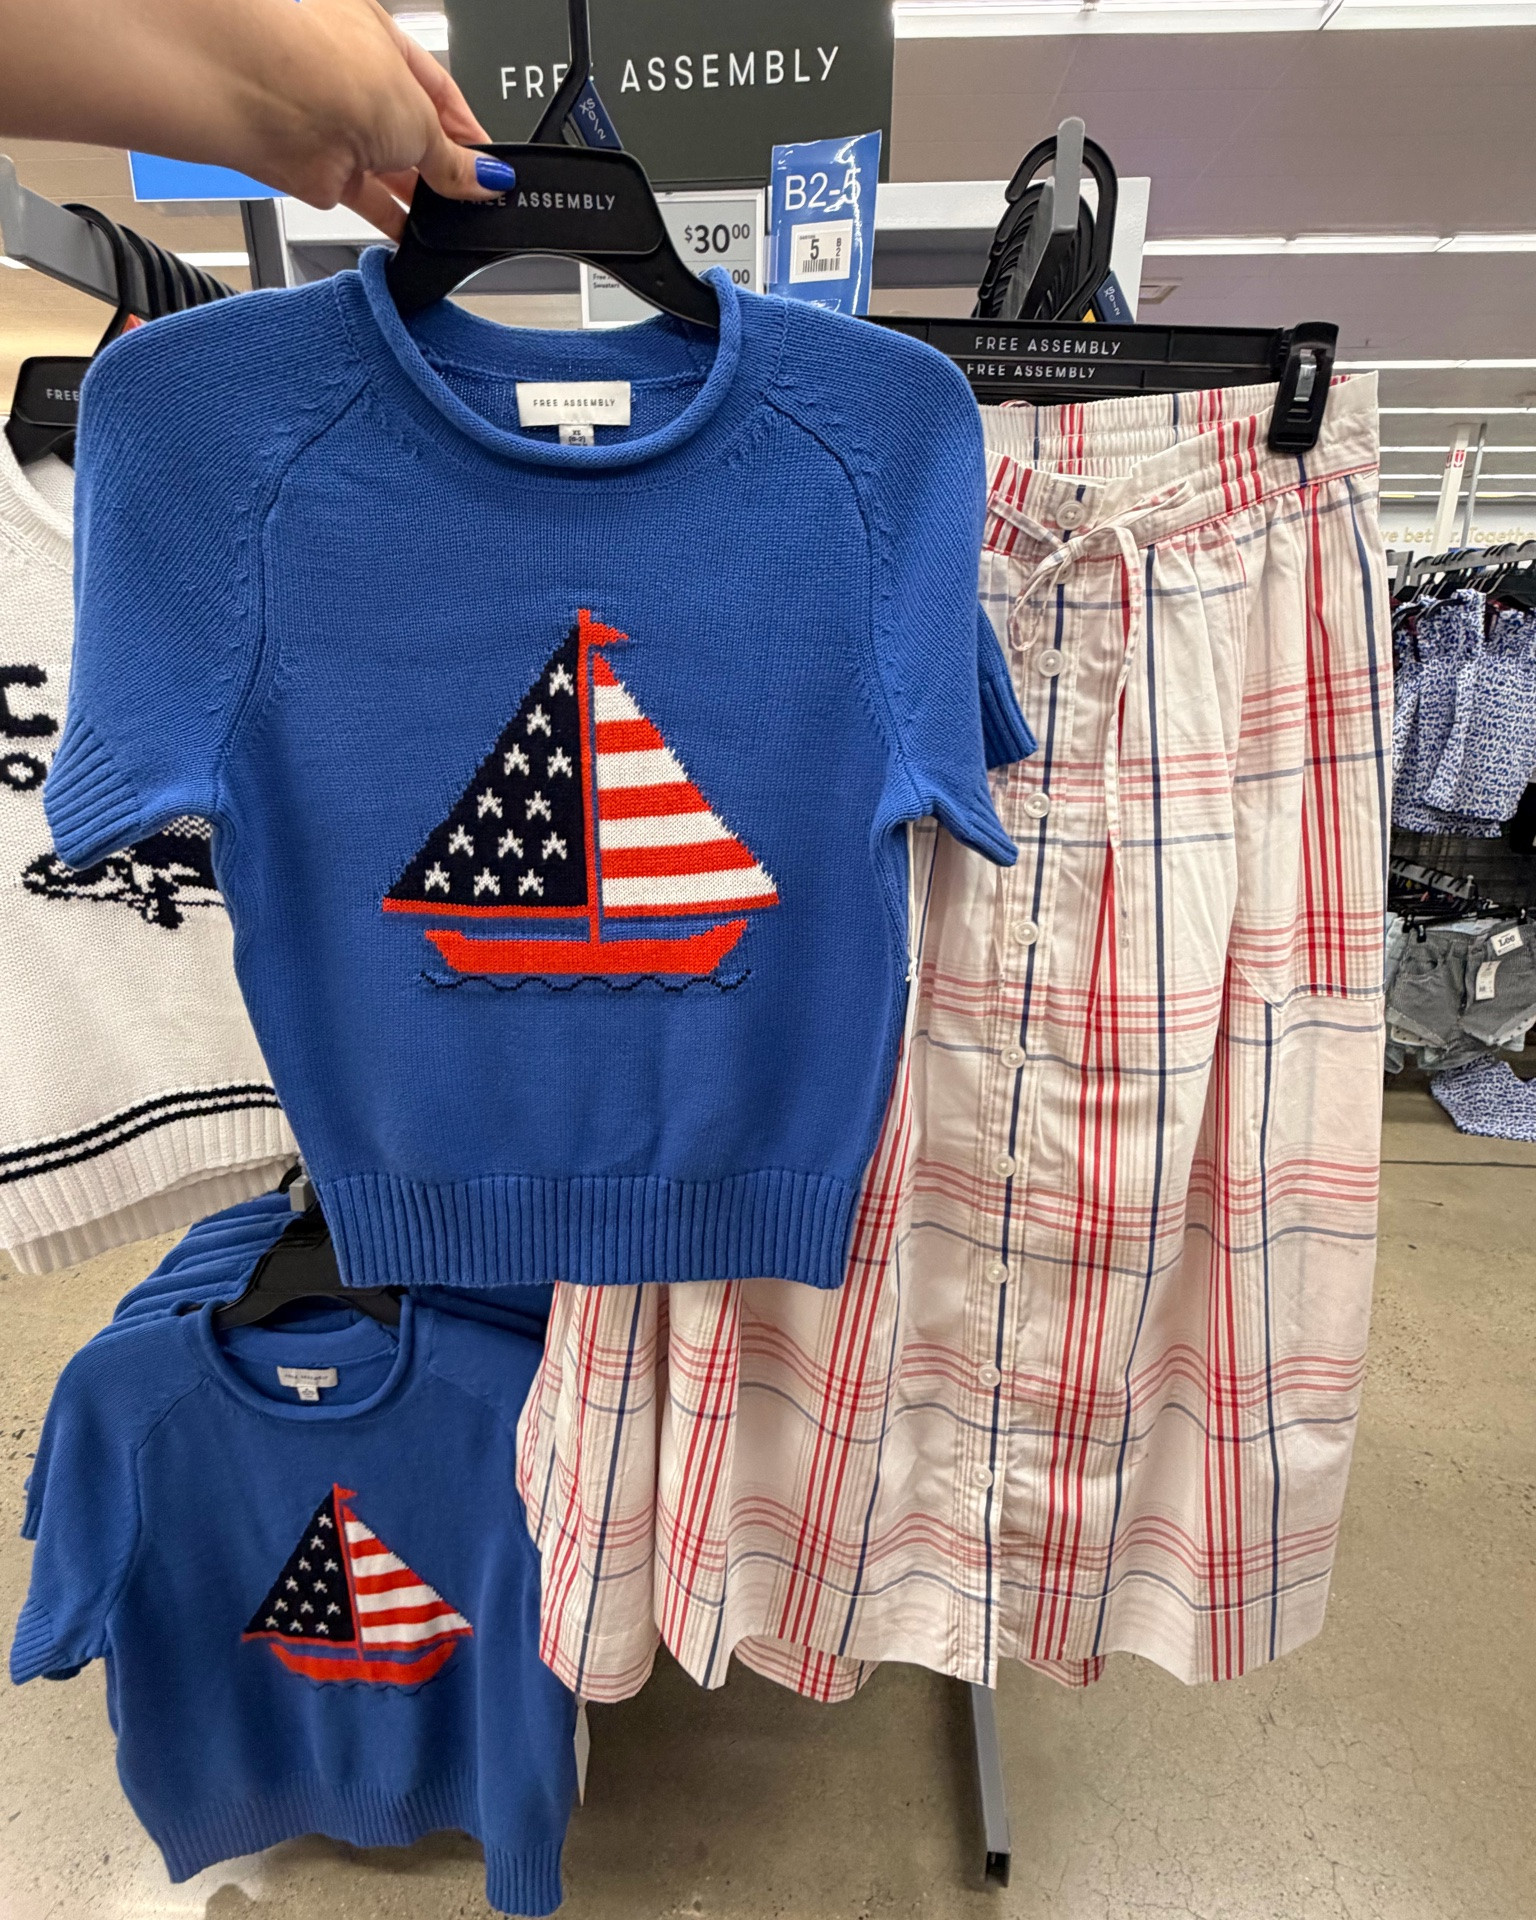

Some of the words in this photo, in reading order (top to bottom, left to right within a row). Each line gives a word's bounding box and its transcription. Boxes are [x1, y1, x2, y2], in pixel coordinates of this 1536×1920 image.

[500, 63, 594, 100] FRE
[620, 46, 839, 93] ASSEMBLY
[784, 168, 862, 211] B2-5
[517, 191, 616, 211] ASSEMBLY
[810, 238, 820, 260] 5
[975, 336, 1019, 351] FREE
[1027, 338, 1121, 355] ASSEMBLY
[967, 363, 1006, 377] FREE
[1014, 364, 1096, 378] ASSEMBLY
[46, 388, 80, 401] FREE
[533, 399, 558, 407] FREE
[563, 399, 616, 407] ASSEMBLY
